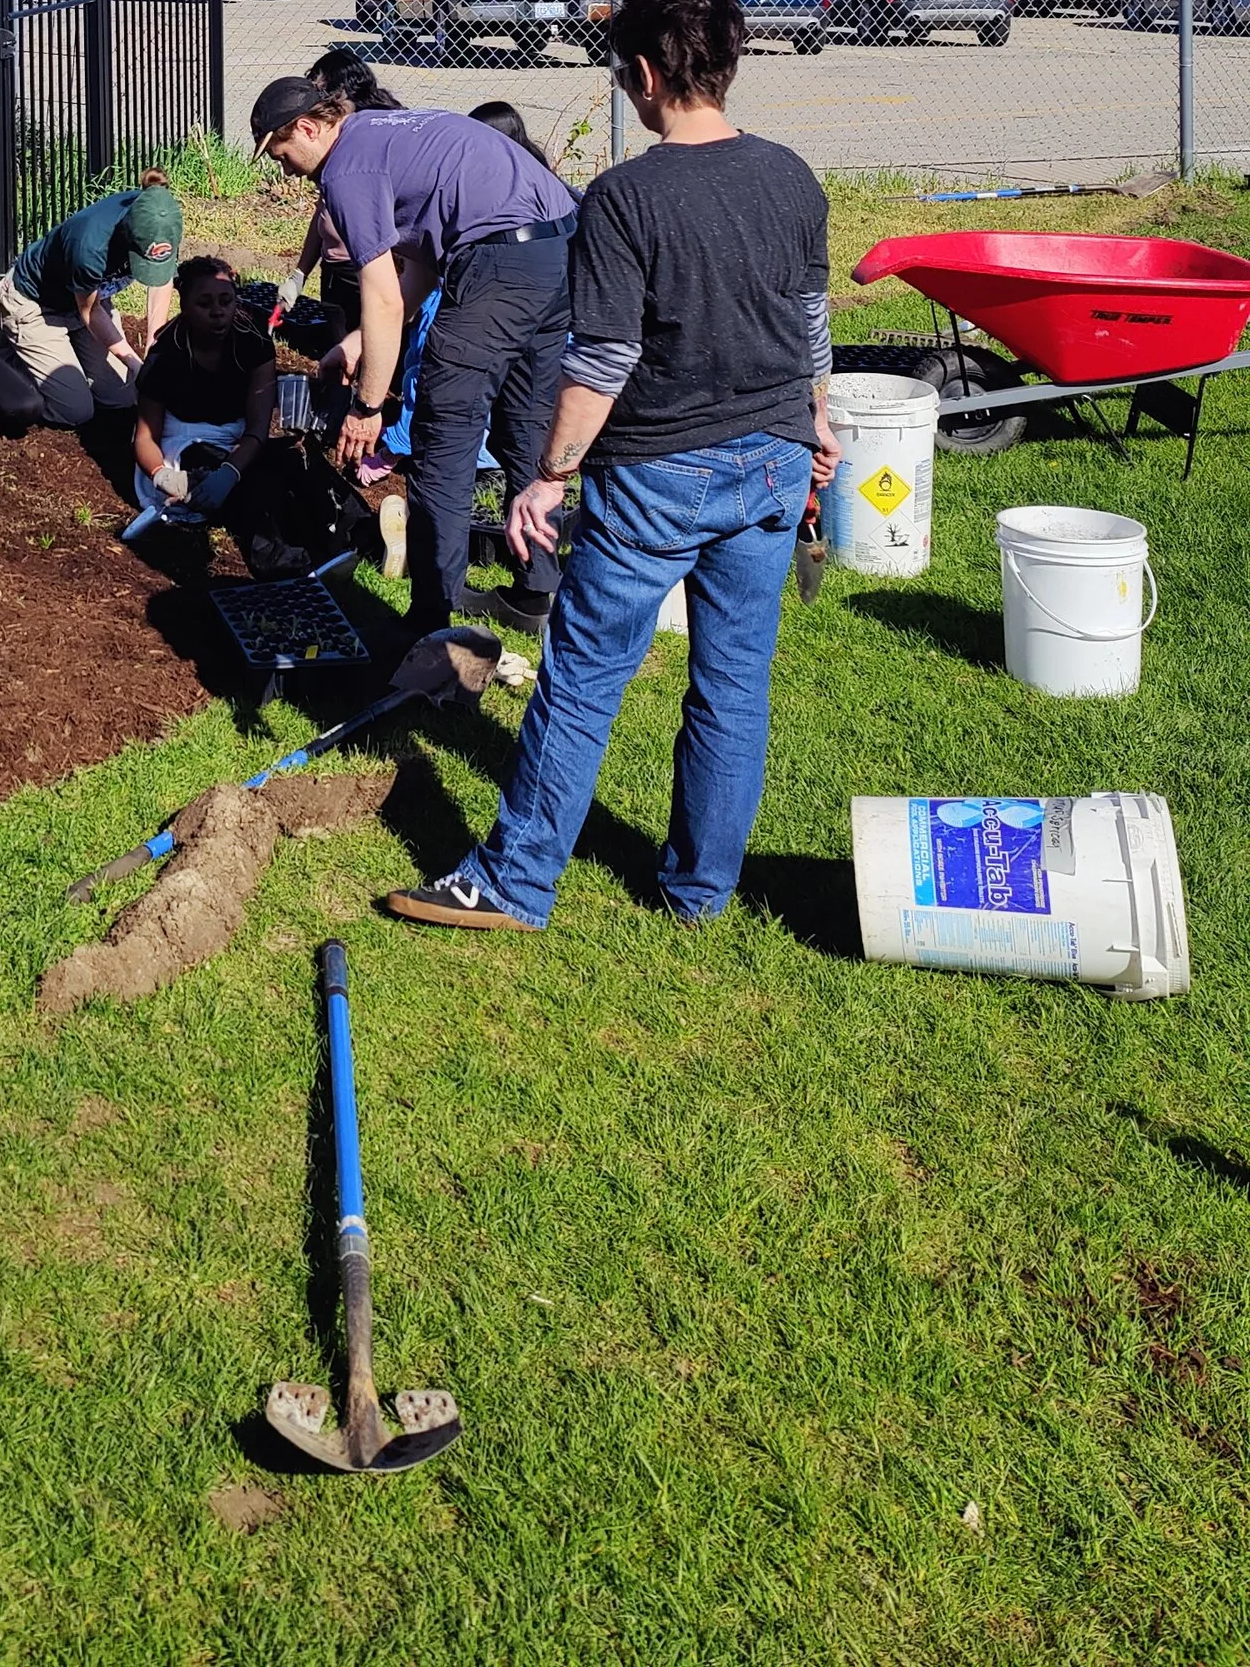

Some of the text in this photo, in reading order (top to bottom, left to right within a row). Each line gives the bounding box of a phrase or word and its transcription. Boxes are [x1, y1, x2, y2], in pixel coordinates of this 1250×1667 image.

[911, 818, 923, 887] APPLICATIONS
[918, 805, 930, 881] COMMERCIAL
[981, 799, 1012, 906] Accu-Tab
